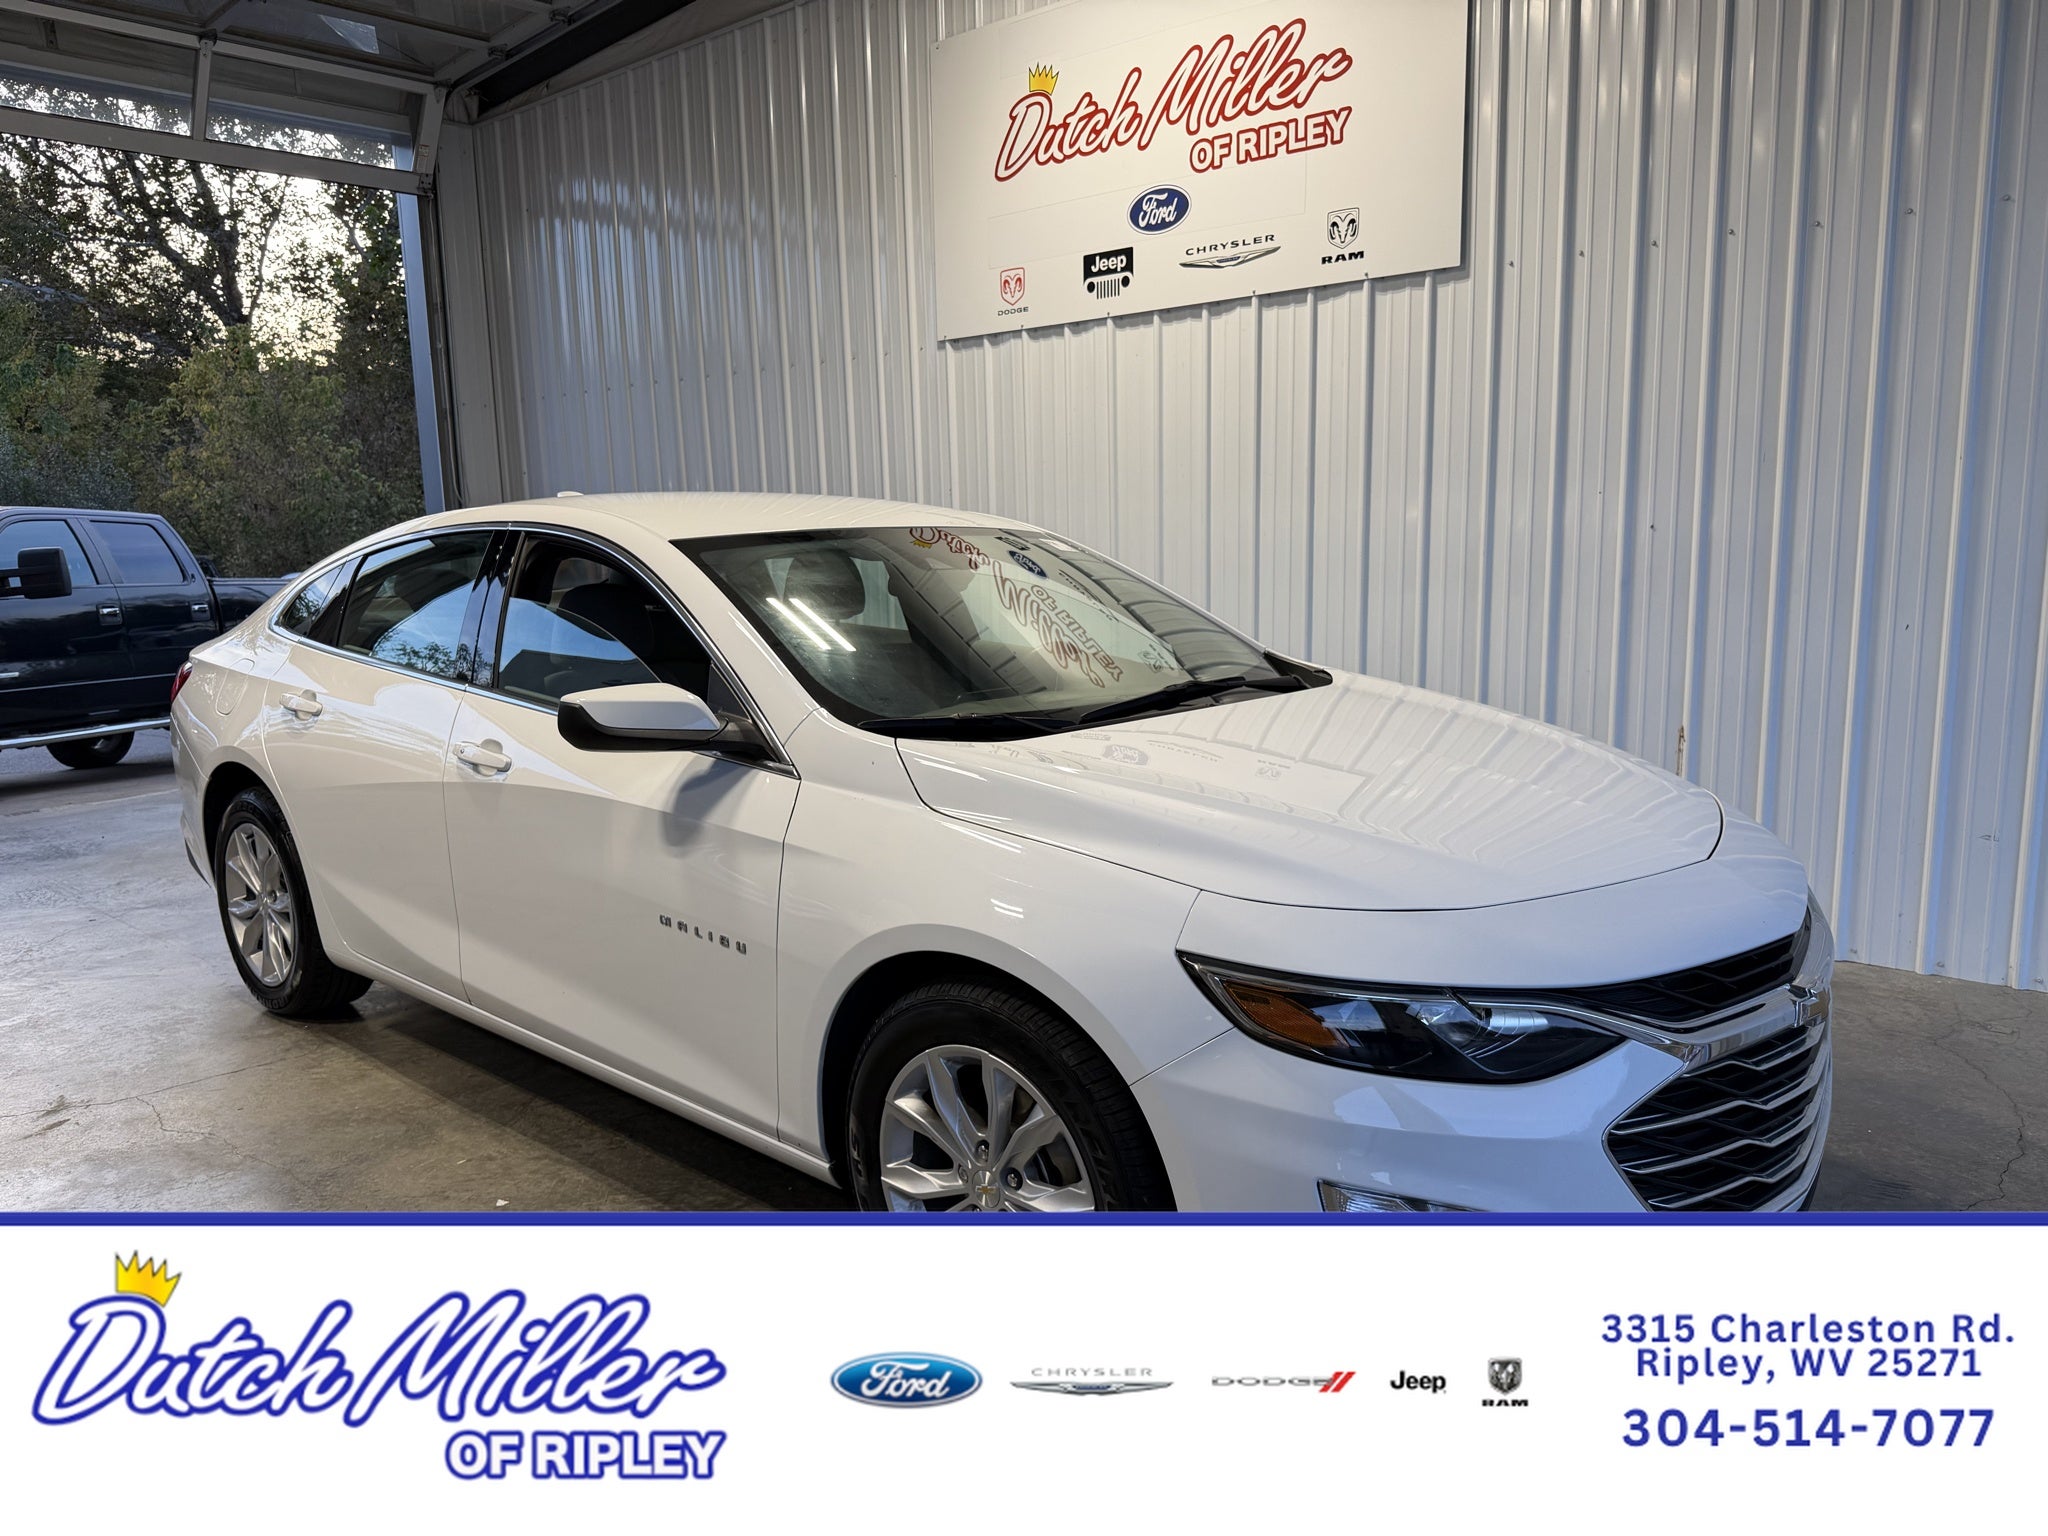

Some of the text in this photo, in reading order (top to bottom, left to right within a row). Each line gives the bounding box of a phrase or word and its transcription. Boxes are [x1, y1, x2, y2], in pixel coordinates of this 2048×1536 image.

[994, 17, 1353, 181] Dutch Miller
[1188, 106, 1353, 174] OF RIPLEY
[1138, 192, 1178, 228] Ford
[1185, 234, 1275, 256] CHRYSLER
[1321, 251, 1365, 265] RAM
[1091, 254, 1127, 273] Jeep
[997, 306, 1029, 316] DODGE
[659, 914, 747, 956] MALIBU
